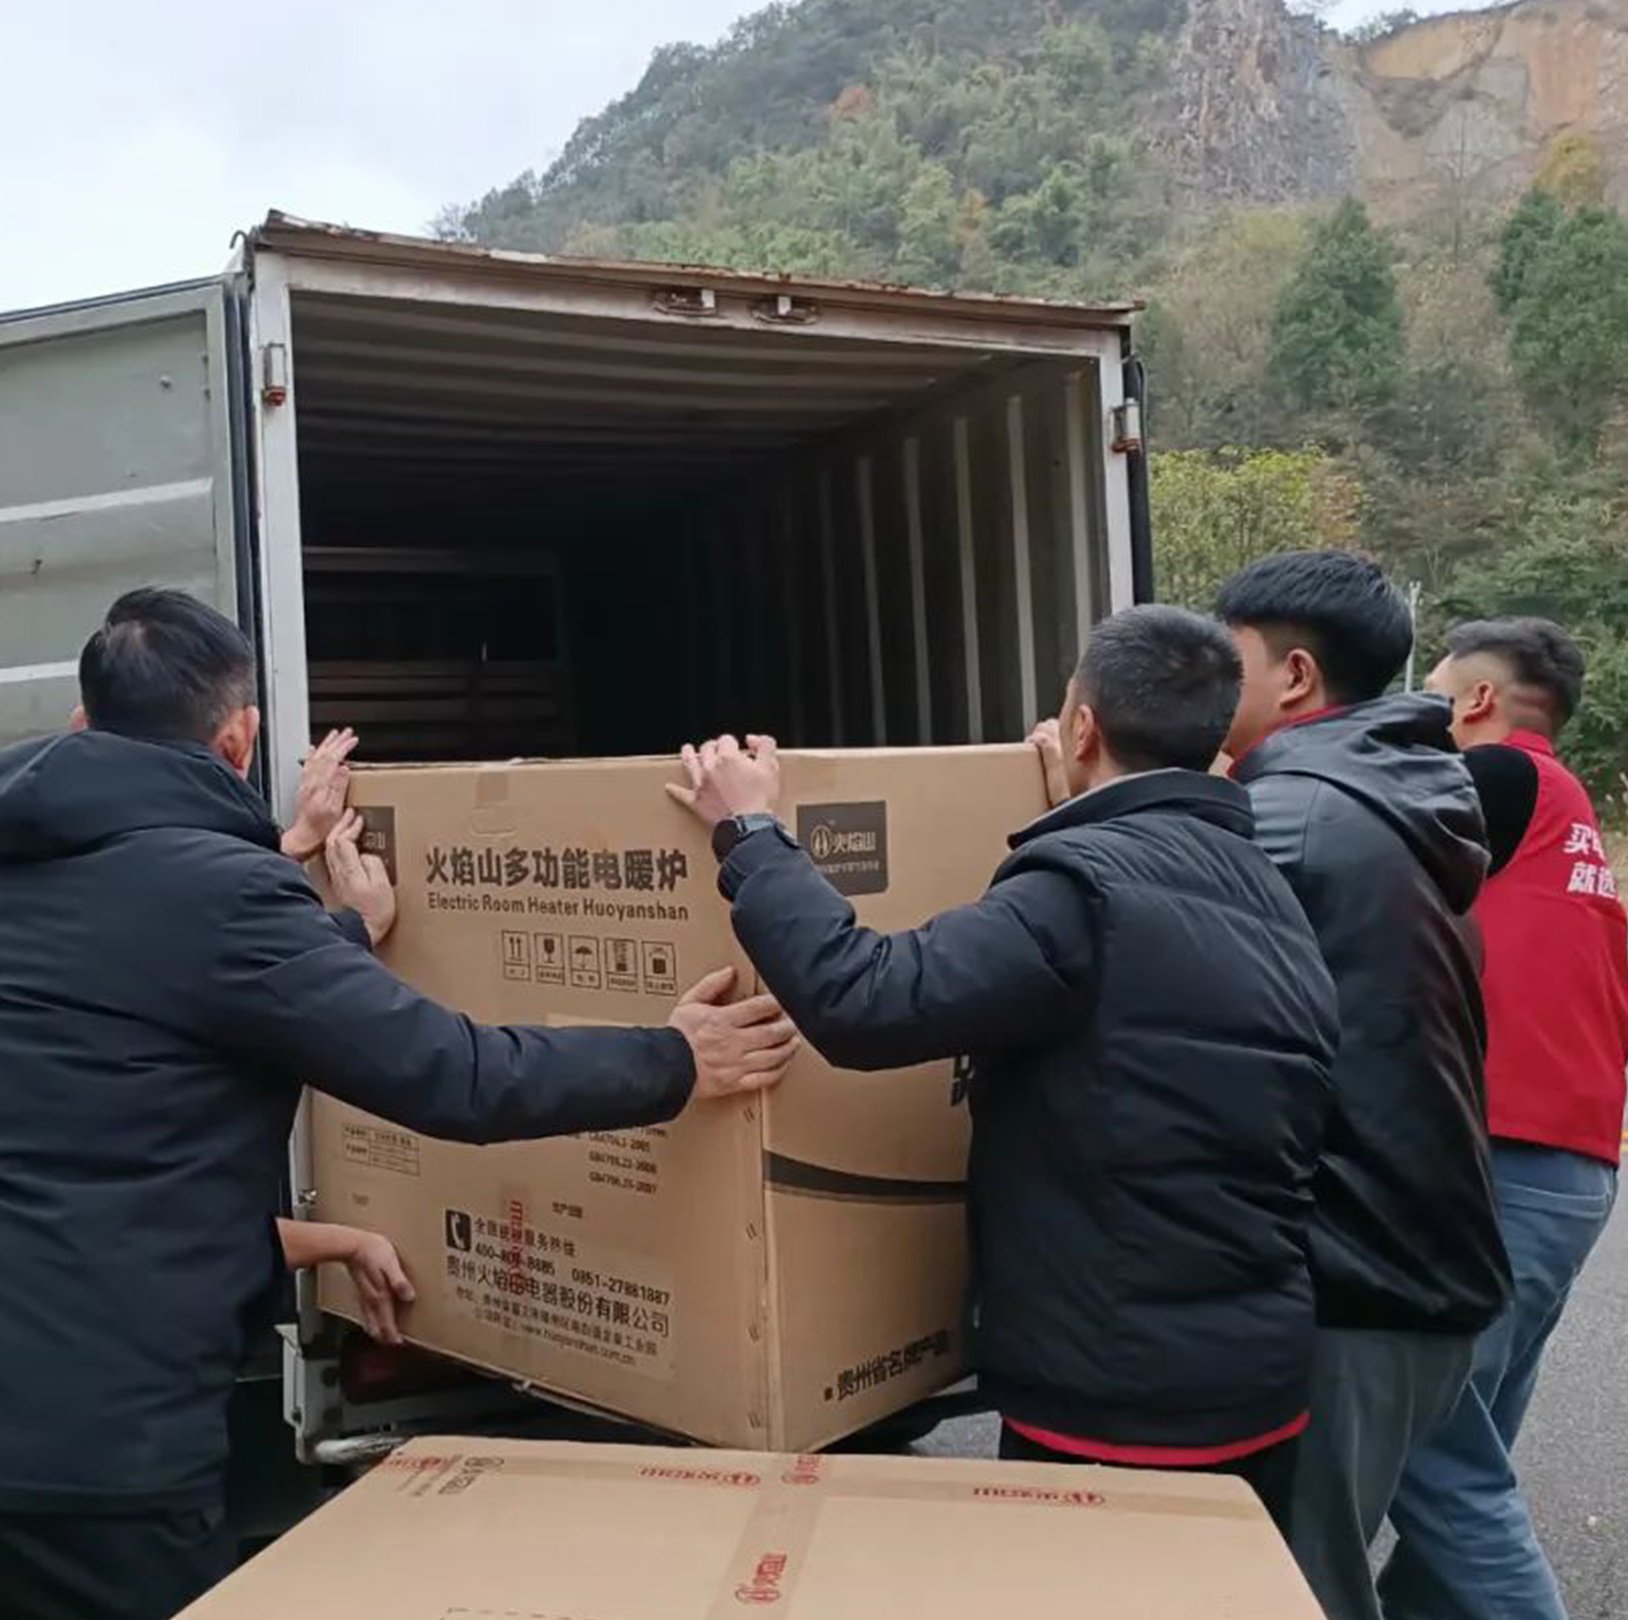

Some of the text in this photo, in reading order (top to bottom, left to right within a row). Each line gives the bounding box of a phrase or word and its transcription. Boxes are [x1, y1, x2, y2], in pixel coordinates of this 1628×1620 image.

[832, 831, 876, 854] 火焰山
[425, 846, 688, 893] 火焰山多功能电暖炉
[428, 891, 689, 922] Electric Room Heater Huoyanshan
